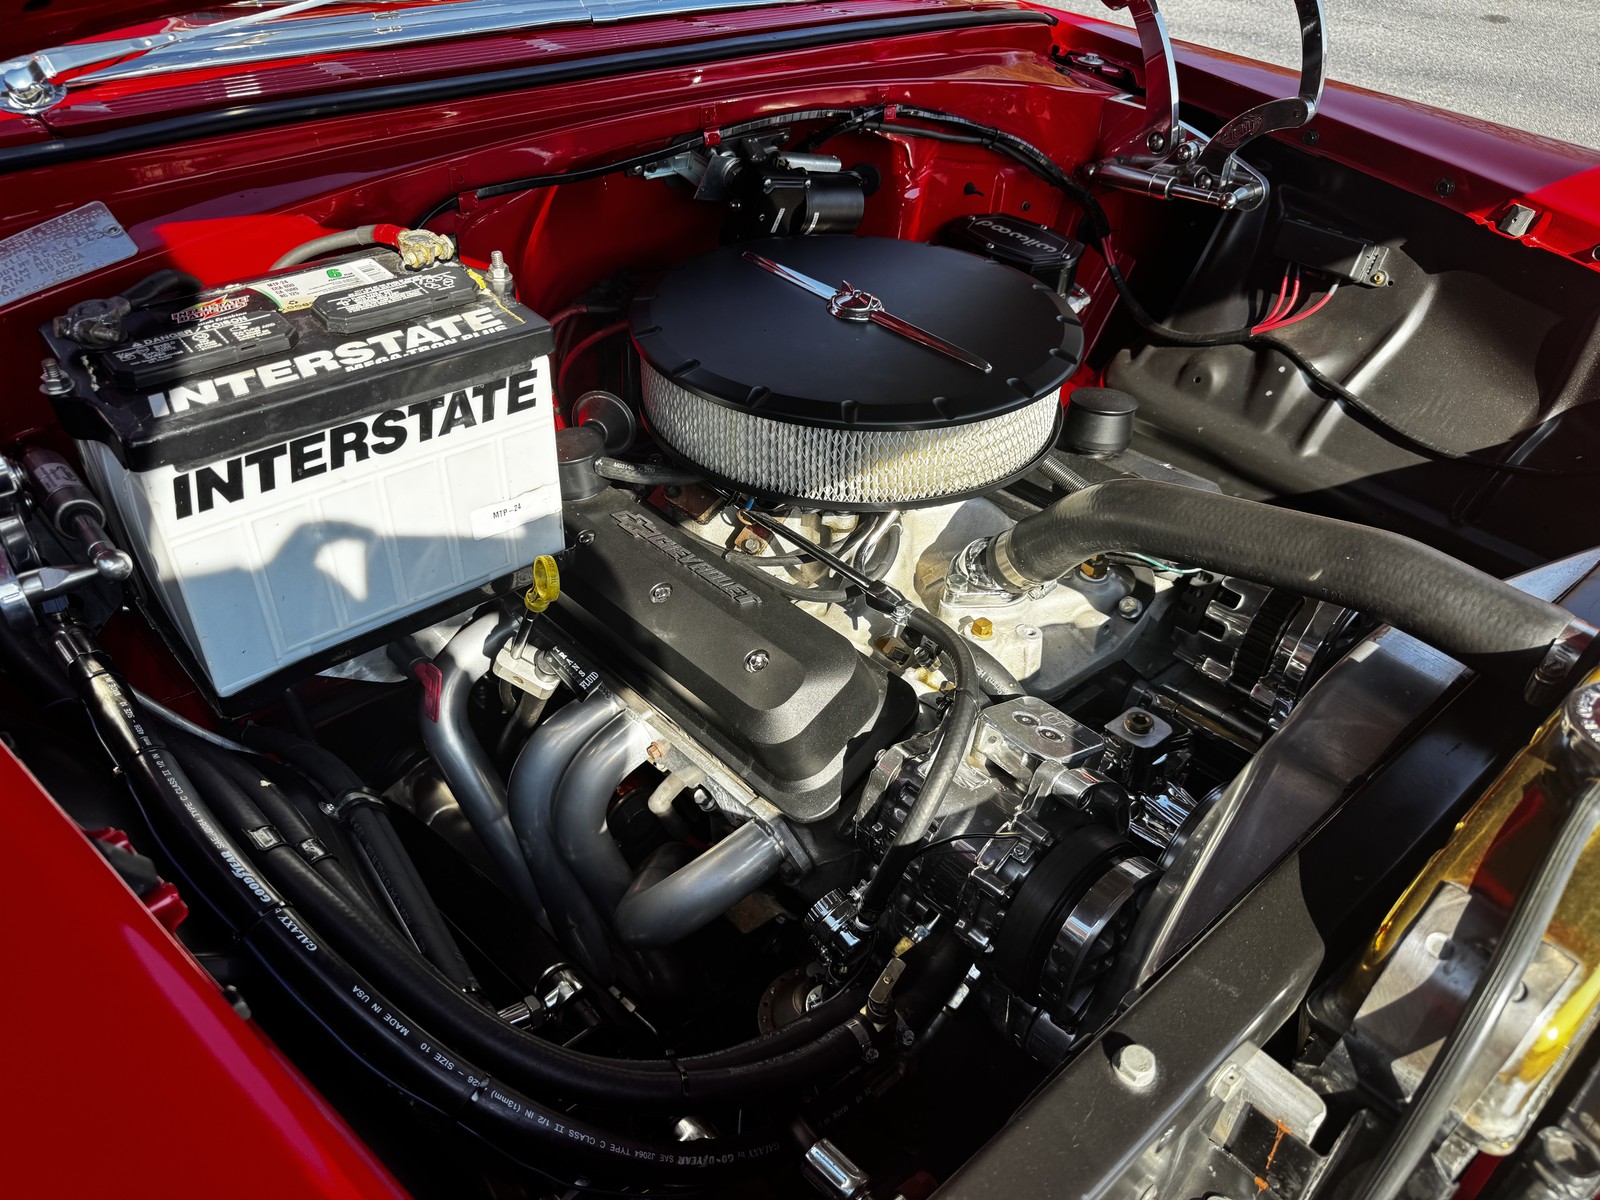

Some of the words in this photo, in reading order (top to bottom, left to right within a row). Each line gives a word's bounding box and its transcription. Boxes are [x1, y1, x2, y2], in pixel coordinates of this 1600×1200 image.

[975, 220, 1057, 253] wilwood
[326, 268, 343, 279] 6
[171, 295, 249, 320] INTERSTATE
[143, 329, 193, 345] DANGER
[204, 315, 248, 330] POISON
[148, 307, 503, 418] INTERSTATE
[173, 368, 538, 520] INTERSTATE
[492, 503, 522, 519] MTP-24
[552, 645, 586, 678] TRANS
[579, 671, 599, 690] FLUID
[167, 777, 183, 795] CLASS
[185, 802, 200, 820] TYPE
[210, 836, 225, 849] SAE
[277, 915, 317, 951] GALAXY
[352, 985, 370, 1002] USA
[371, 1003, 383, 1014] IN
[383, 1012, 410, 1036] MADE
[420, 1042, 430, 1053] 10
[434, 1052, 455, 1070] SIZE
[491, 1090, 521, 1113] (13mm)
[524, 1109, 534, 1119] IN
[537, 1116, 550, 1127] 1/2
[554, 1123, 565, 1134] II
[568, 1129, 595, 1145] CLASS
[600, 1140, 606, 1148] C
[609, 1143, 630, 1156] TYPE
[634, 1150, 655, 1160] J2064
[660, 1154, 674, 1163] SAE
